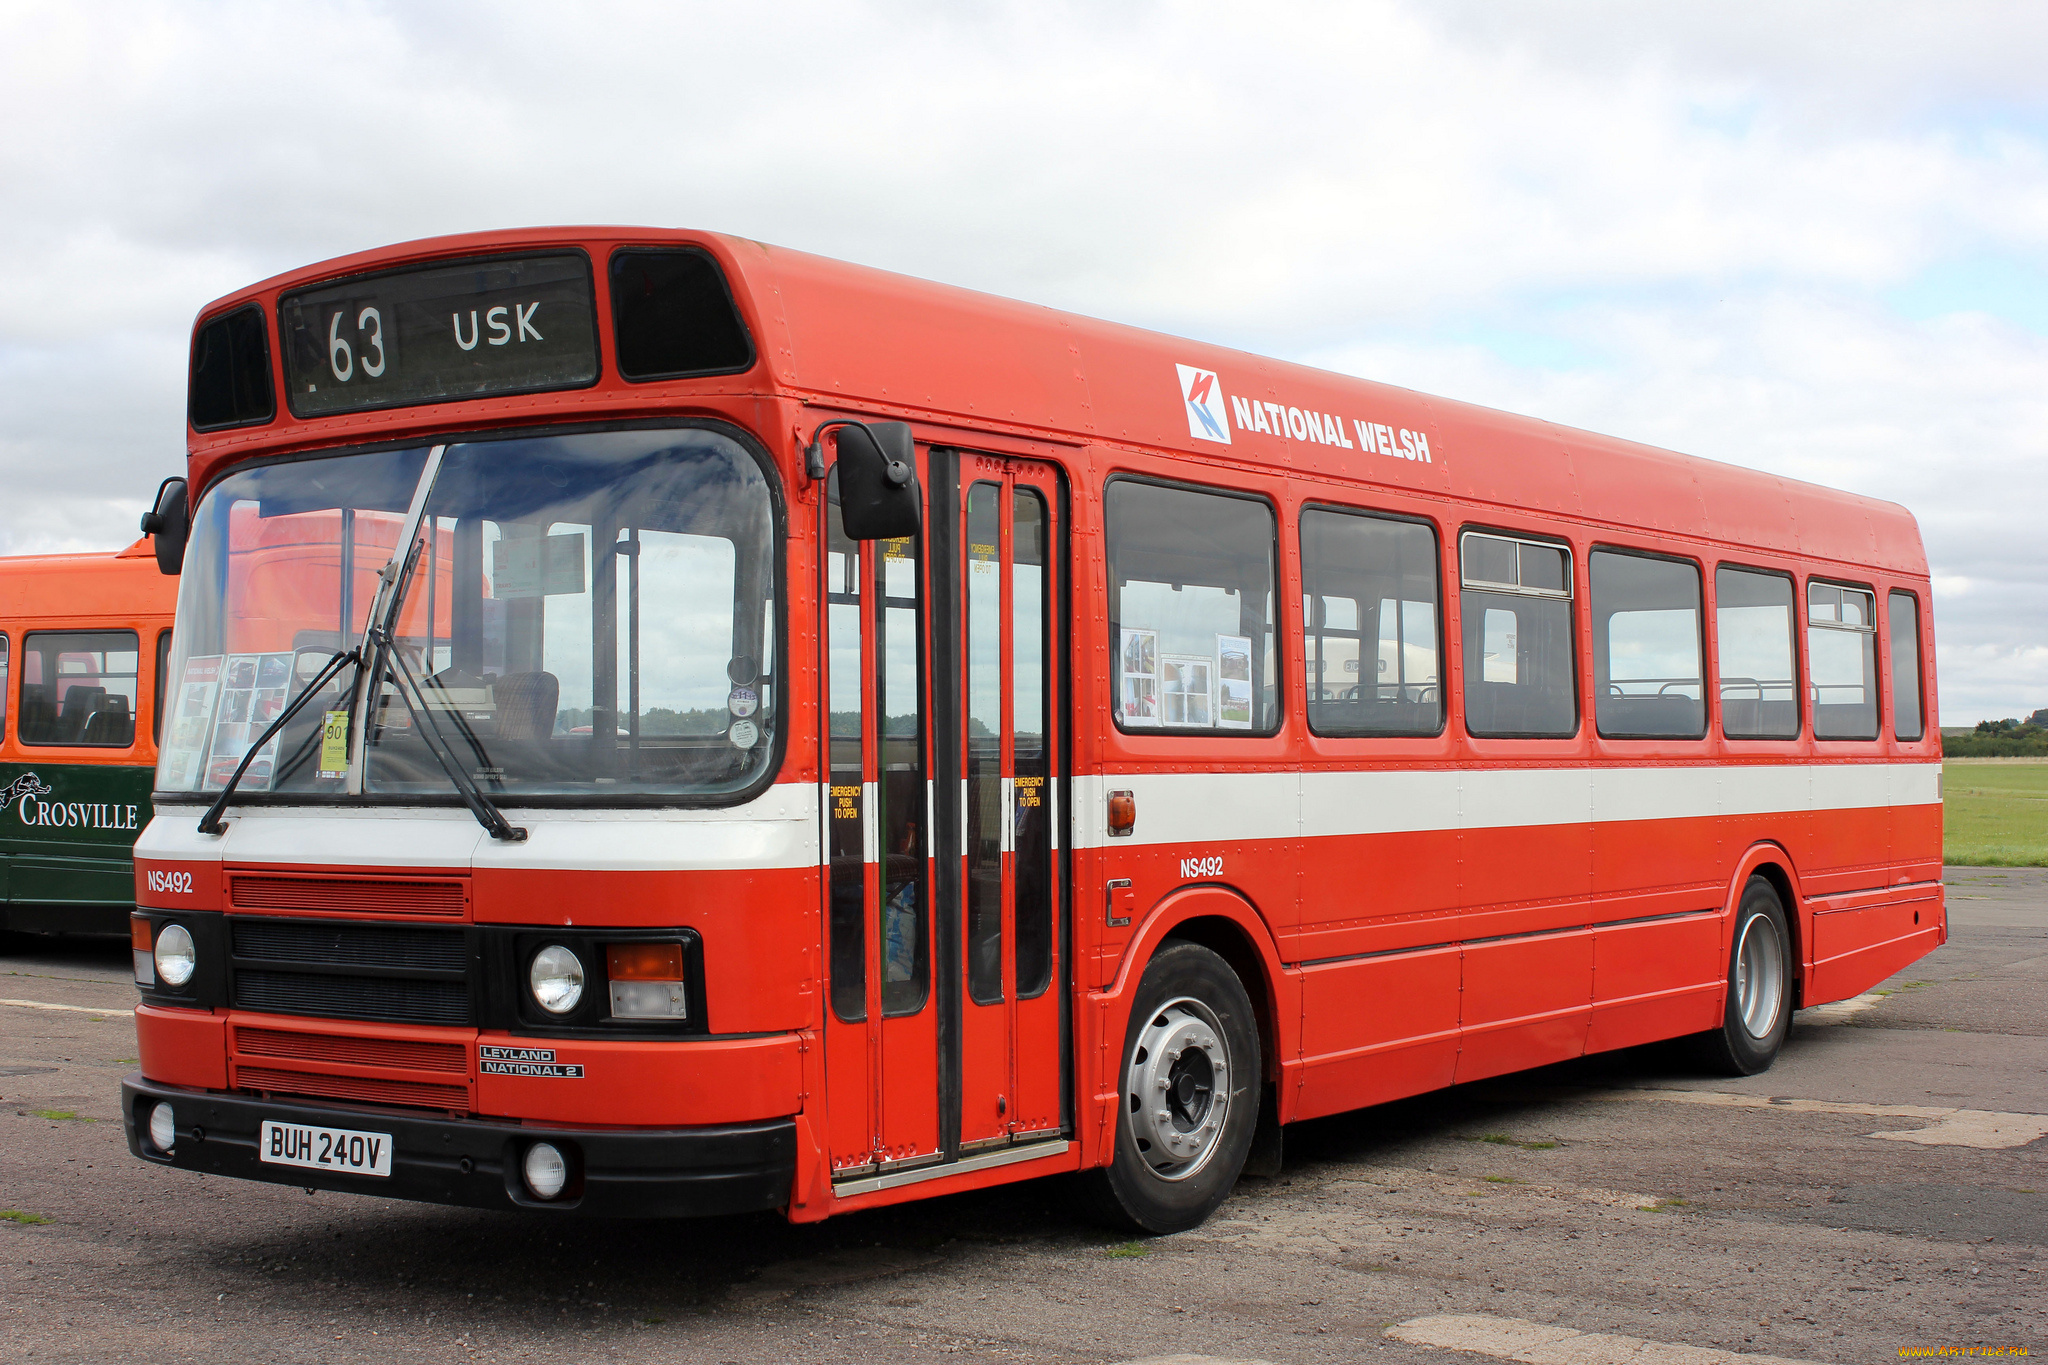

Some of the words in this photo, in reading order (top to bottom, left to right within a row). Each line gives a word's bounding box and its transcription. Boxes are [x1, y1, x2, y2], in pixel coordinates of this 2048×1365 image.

[328, 306, 386, 382] 63
[452, 301, 544, 351] USK
[1230, 394, 1354, 450] NATIONAL
[1353, 418, 1432, 463] WELSH
[326, 725, 348, 740] 90
[1014, 776, 1044, 787] EMERGENCY
[830, 785, 862, 797] EMERGENCY
[1023, 787, 1036, 797] PUSH
[838, 797, 853, 808] PUSH
[1019, 797, 1026, 807] TO
[1026, 796, 1041, 807] OPEN
[18, 793, 138, 830] CROSVILLE
[834, 808, 842, 818] TO
[842, 807, 858, 819] OPEN
[1180, 856, 1223, 878] NS492
[147, 870, 193, 893] NS492
[483, 1047, 552, 1061] LEYLAND
[486, 1062, 563, 1076] NATIONAL
[565, 1066, 577, 1076] 2
[270, 1126, 312, 1161] BUH
[318, 1132, 381, 1169] 240V
